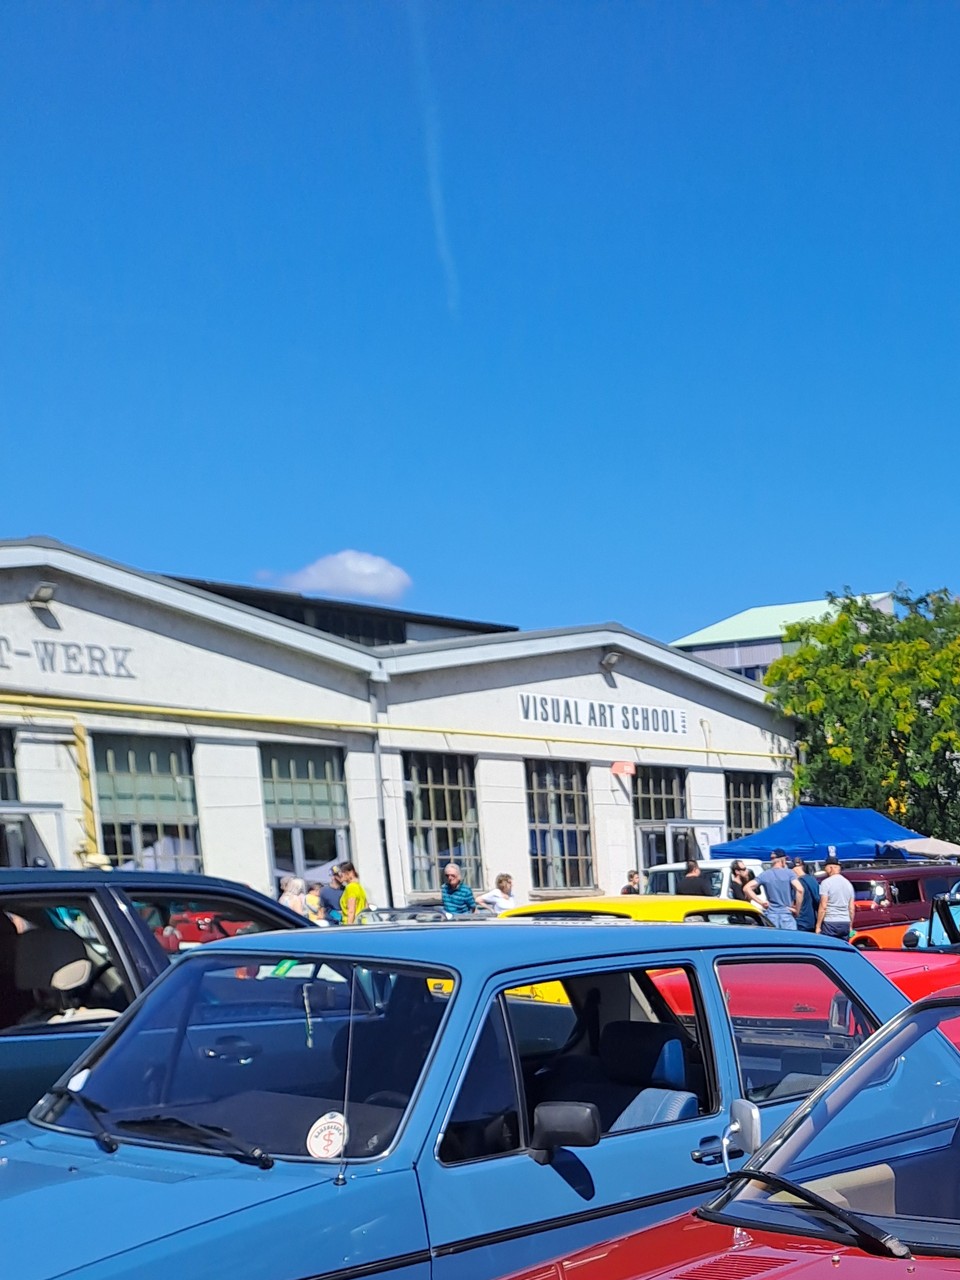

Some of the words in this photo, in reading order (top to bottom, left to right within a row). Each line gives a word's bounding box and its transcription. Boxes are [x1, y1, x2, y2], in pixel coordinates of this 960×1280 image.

[519, 693, 582, 725] VISUAL
[588, 702, 615, 728] ART
[622, 706, 678, 733] SCHOOL
